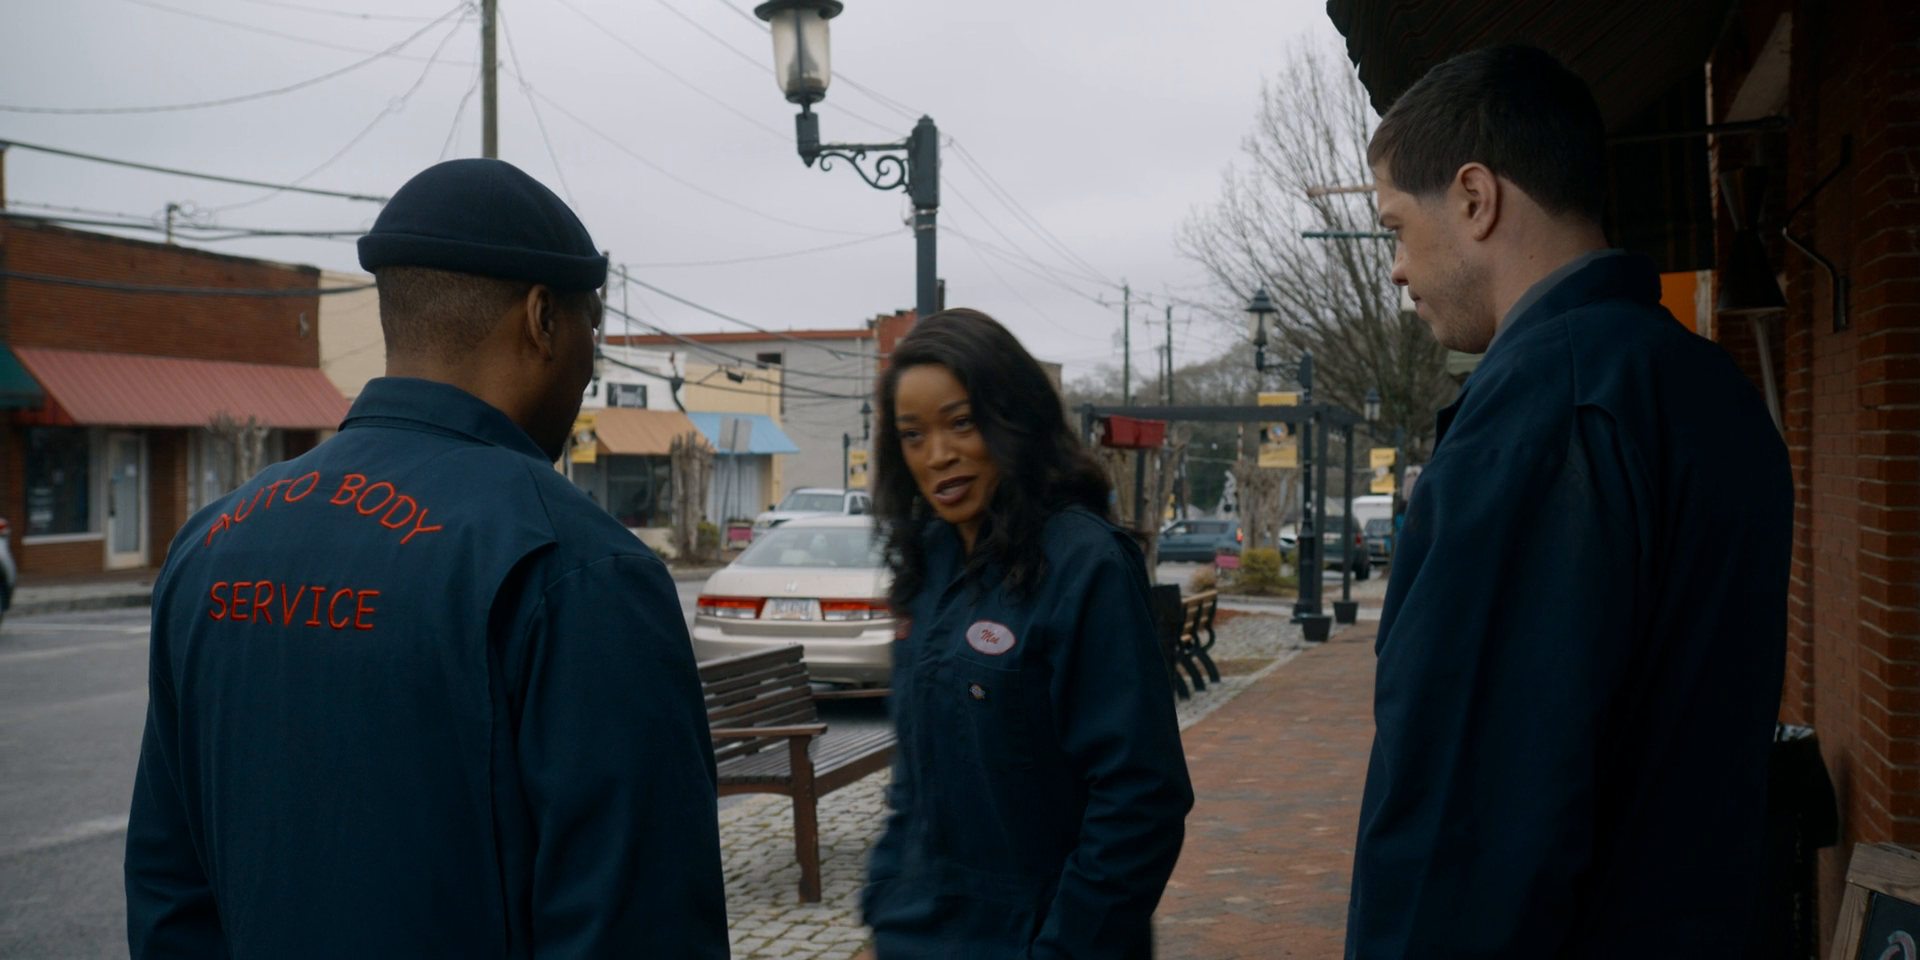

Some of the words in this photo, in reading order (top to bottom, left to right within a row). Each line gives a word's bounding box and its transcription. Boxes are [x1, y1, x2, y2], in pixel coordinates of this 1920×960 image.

[205, 472, 321, 546] AUTO
[330, 473, 442, 544] BODY
[209, 581, 381, 629] SERVICE
